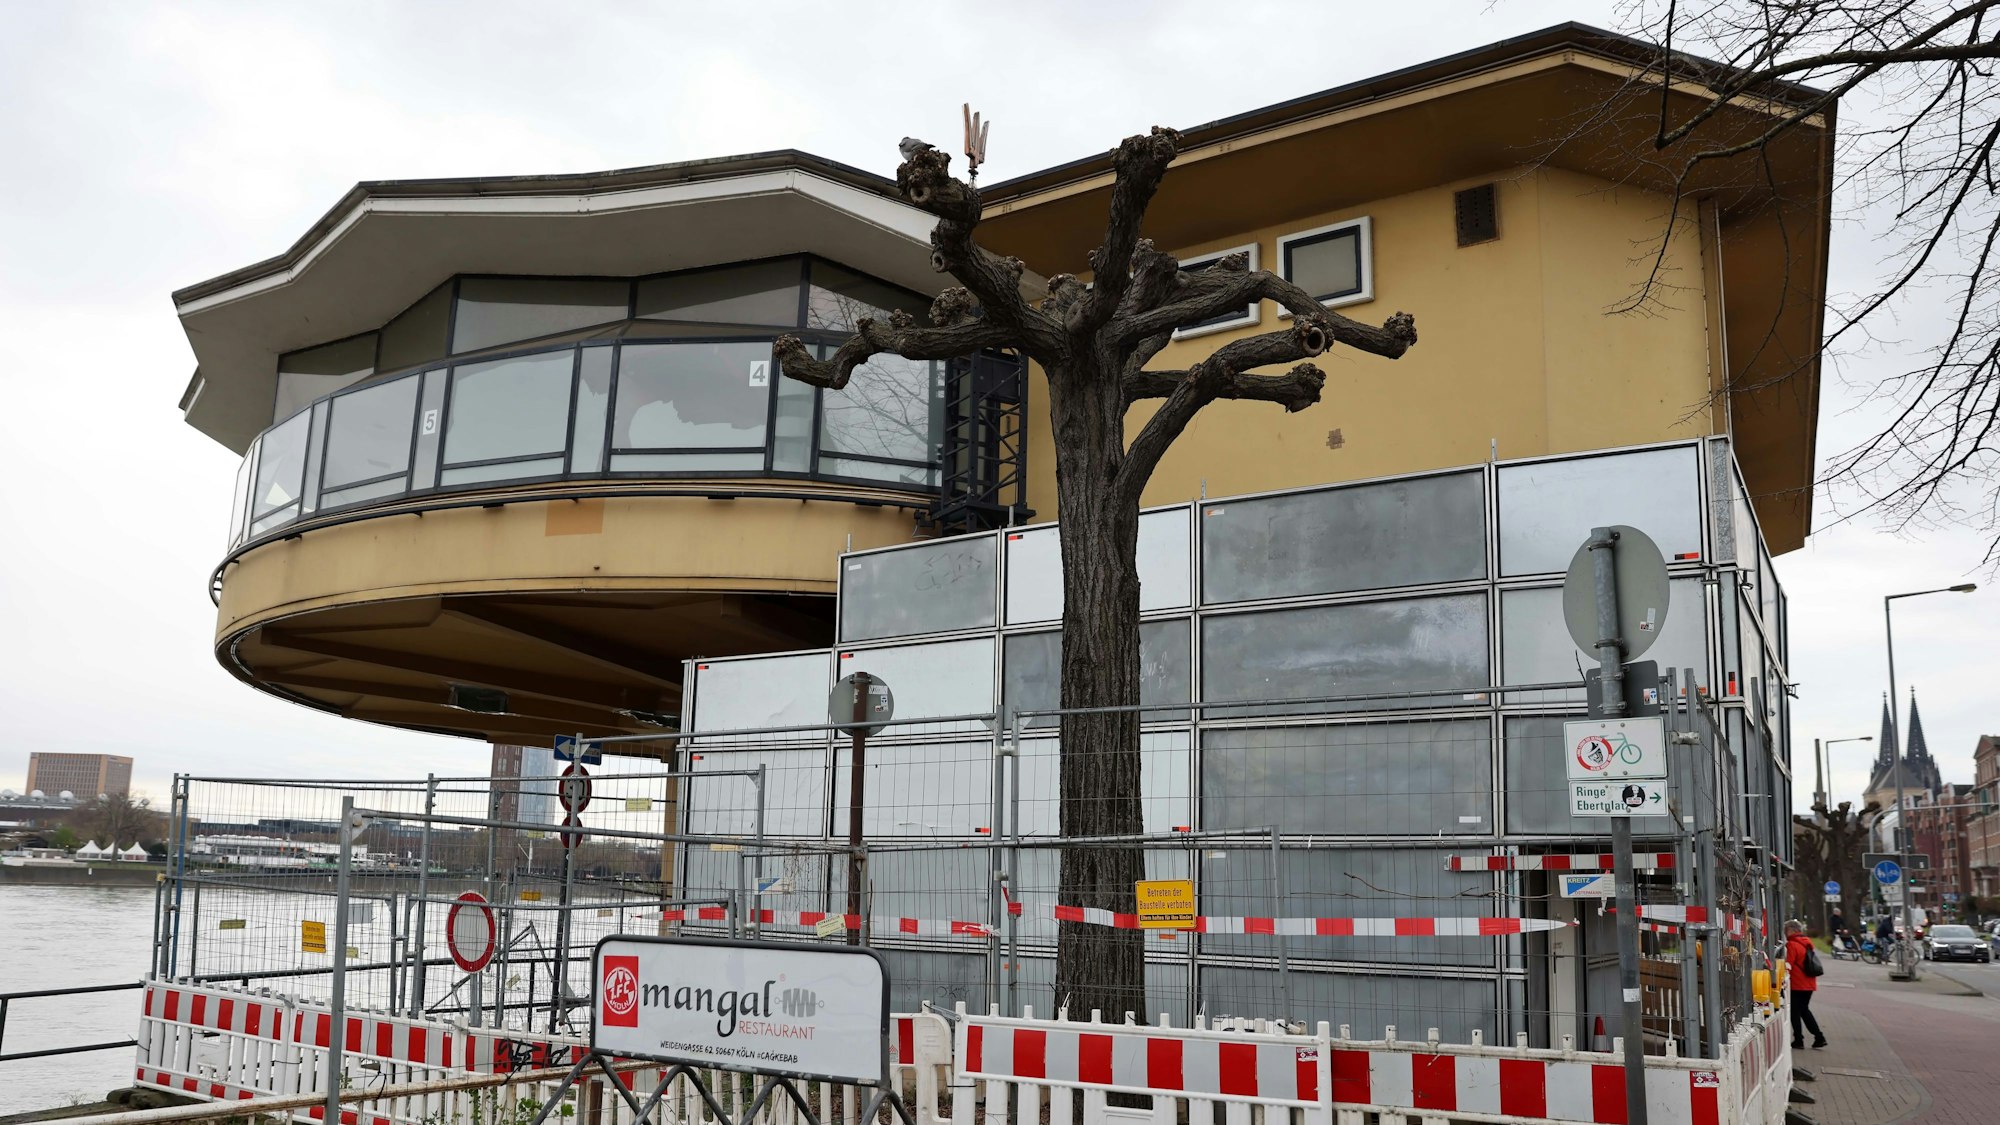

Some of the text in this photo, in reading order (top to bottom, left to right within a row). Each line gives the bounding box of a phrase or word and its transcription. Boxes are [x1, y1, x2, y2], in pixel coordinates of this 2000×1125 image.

[752, 364, 766, 383] 4
[425, 413, 435, 432] 5
[1576, 786, 1606, 799] Ringe
[1147, 888, 1182, 897] Betreten der
[1139, 900, 1192, 909] Baustelle verboten
[641, 979, 777, 1038] mangal
[738, 1020, 816, 1041] RESTAURANT
[660, 1040, 703, 1053] WEIDENGASSE
[715, 1046, 735, 1056] 50667
[736, 1046, 756, 1058] KÖLN
